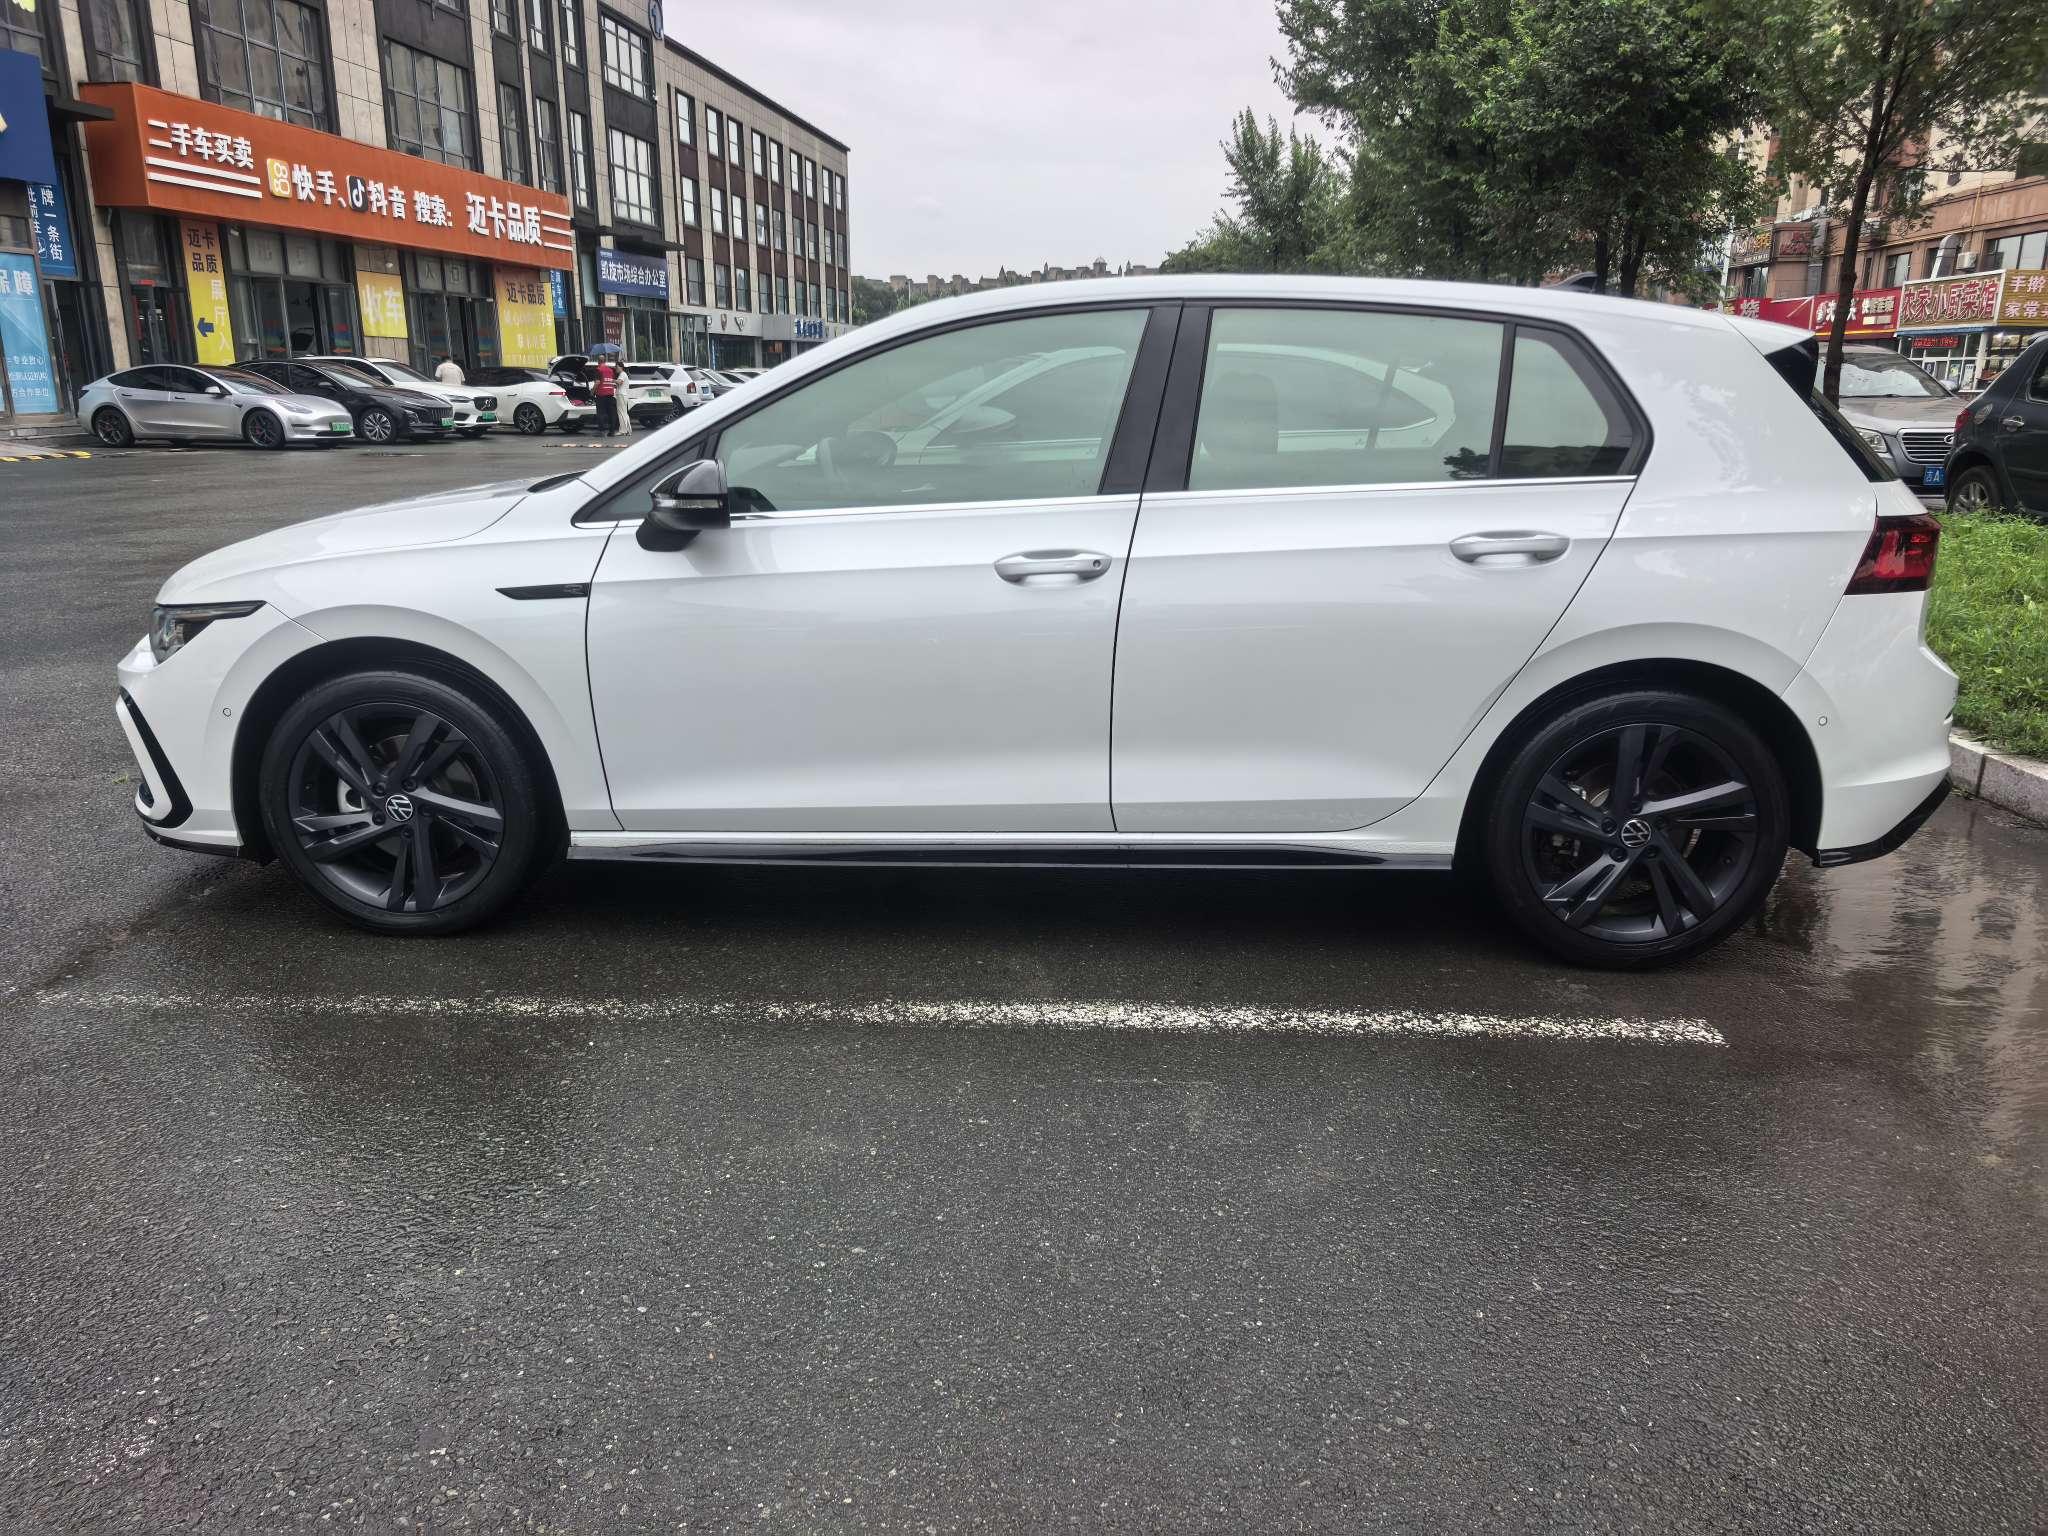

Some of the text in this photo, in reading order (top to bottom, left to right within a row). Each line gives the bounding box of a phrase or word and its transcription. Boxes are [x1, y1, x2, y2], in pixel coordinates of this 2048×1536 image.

[147, 119, 254, 170] 二手车买卖
[367, 179, 407, 220] 抖音
[465, 191, 543, 246] 迈卡品质
[187, 227, 215, 250] 迈卡
[191, 252, 219, 273] 品质
[506, 280, 546, 306] 迈卡品质
